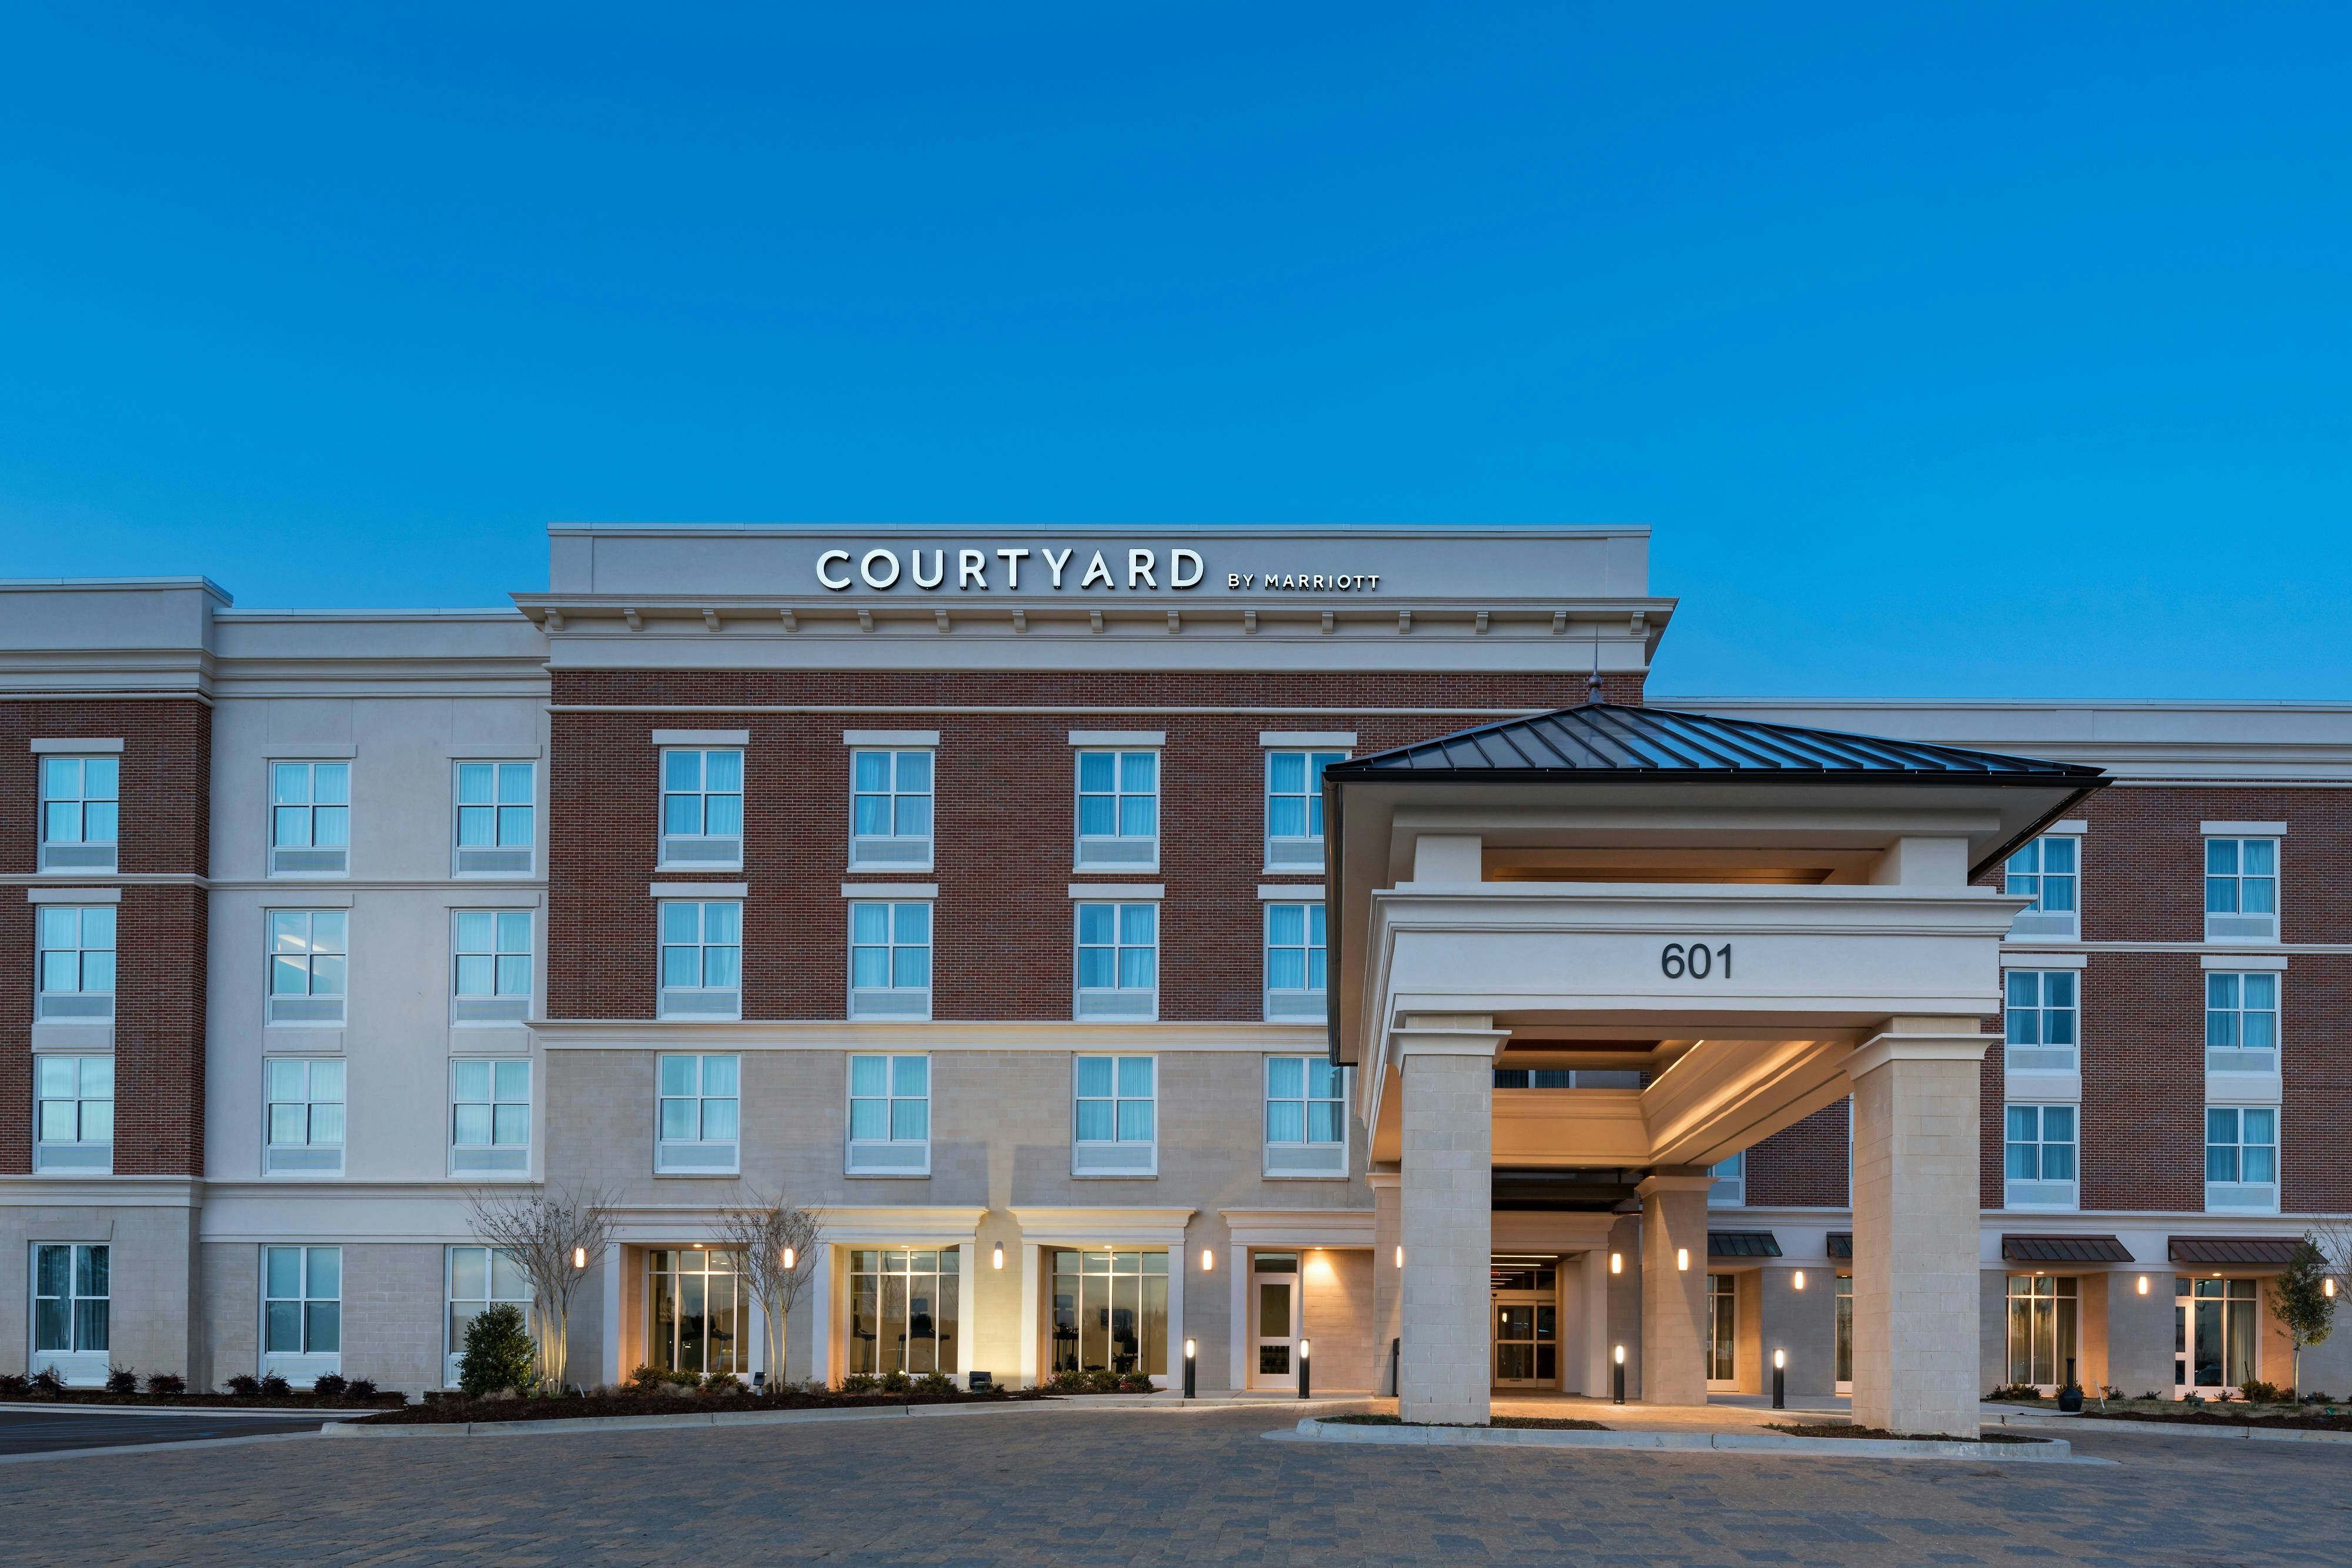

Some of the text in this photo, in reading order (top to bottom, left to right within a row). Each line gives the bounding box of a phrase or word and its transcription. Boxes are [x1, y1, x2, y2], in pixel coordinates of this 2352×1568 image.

[816, 549, 1204, 590] COURTYARD
[1228, 573, 1379, 591] BY MARRIOTT
[1662, 943, 1730, 979] 601
